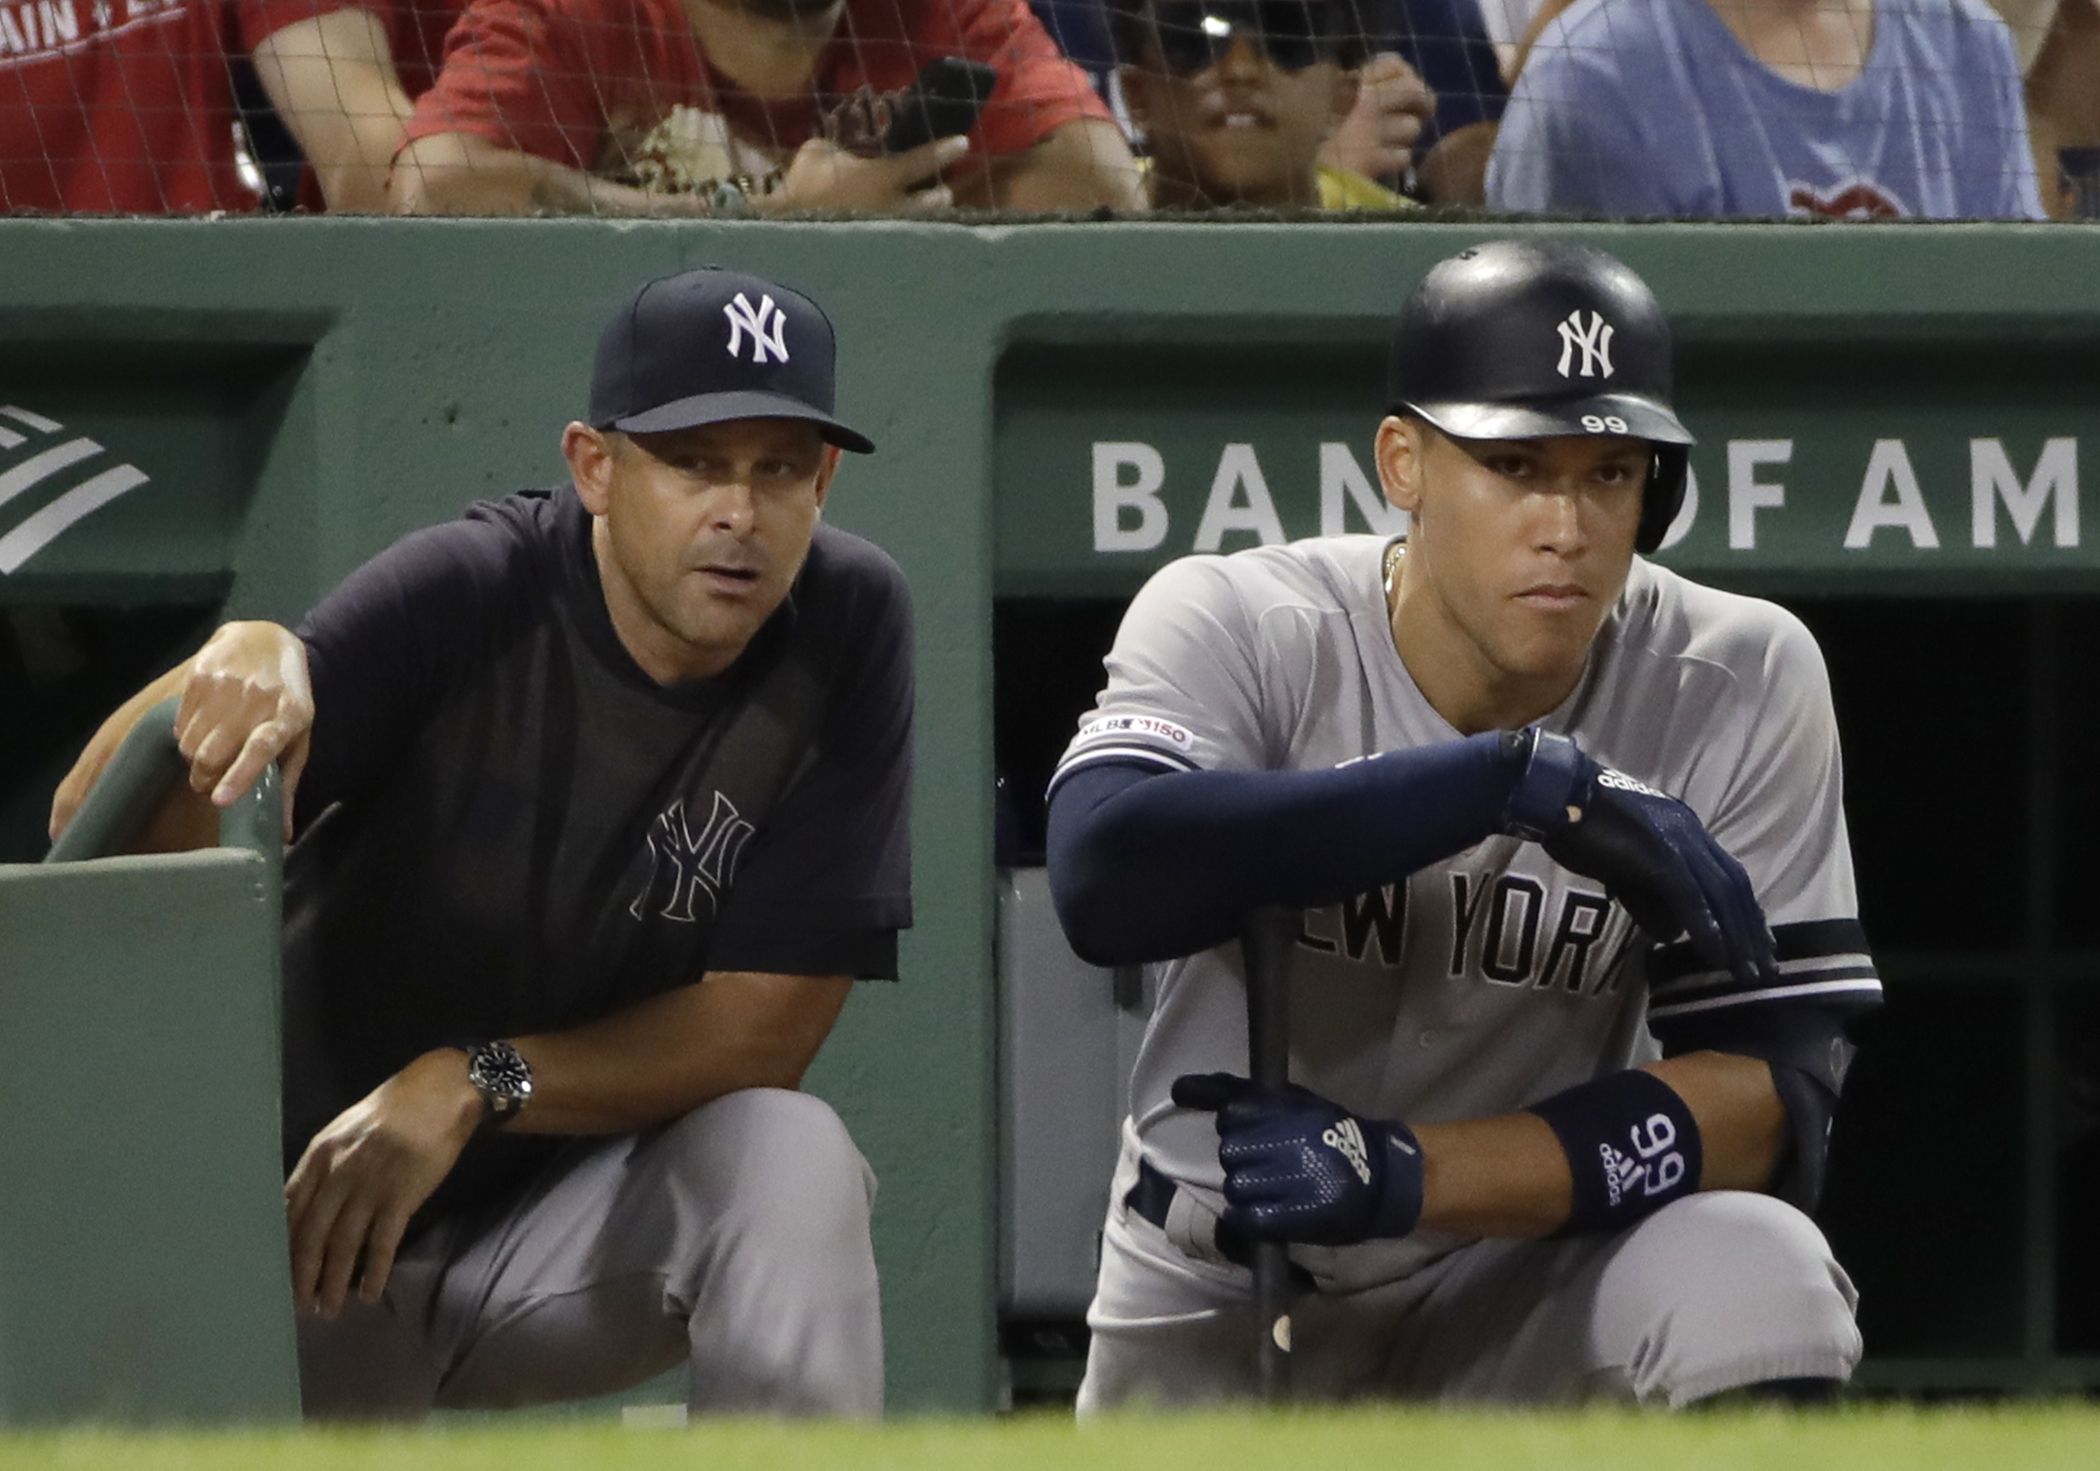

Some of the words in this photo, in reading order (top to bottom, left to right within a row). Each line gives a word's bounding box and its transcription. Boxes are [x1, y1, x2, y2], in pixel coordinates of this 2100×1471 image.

[723, 292, 789, 364] NY
[1556, 309, 1615, 379] NY
[1580, 414, 1628, 435] 99
[1092, 441, 1409, 552] BAN
[1152, 720, 1187, 744] 150
[629, 789, 756, 922] NY
[1322, 1128, 1371, 1185] adidas
[1599, 1142, 1621, 1207] adidas
[1630, 1112, 1685, 1197] 99
